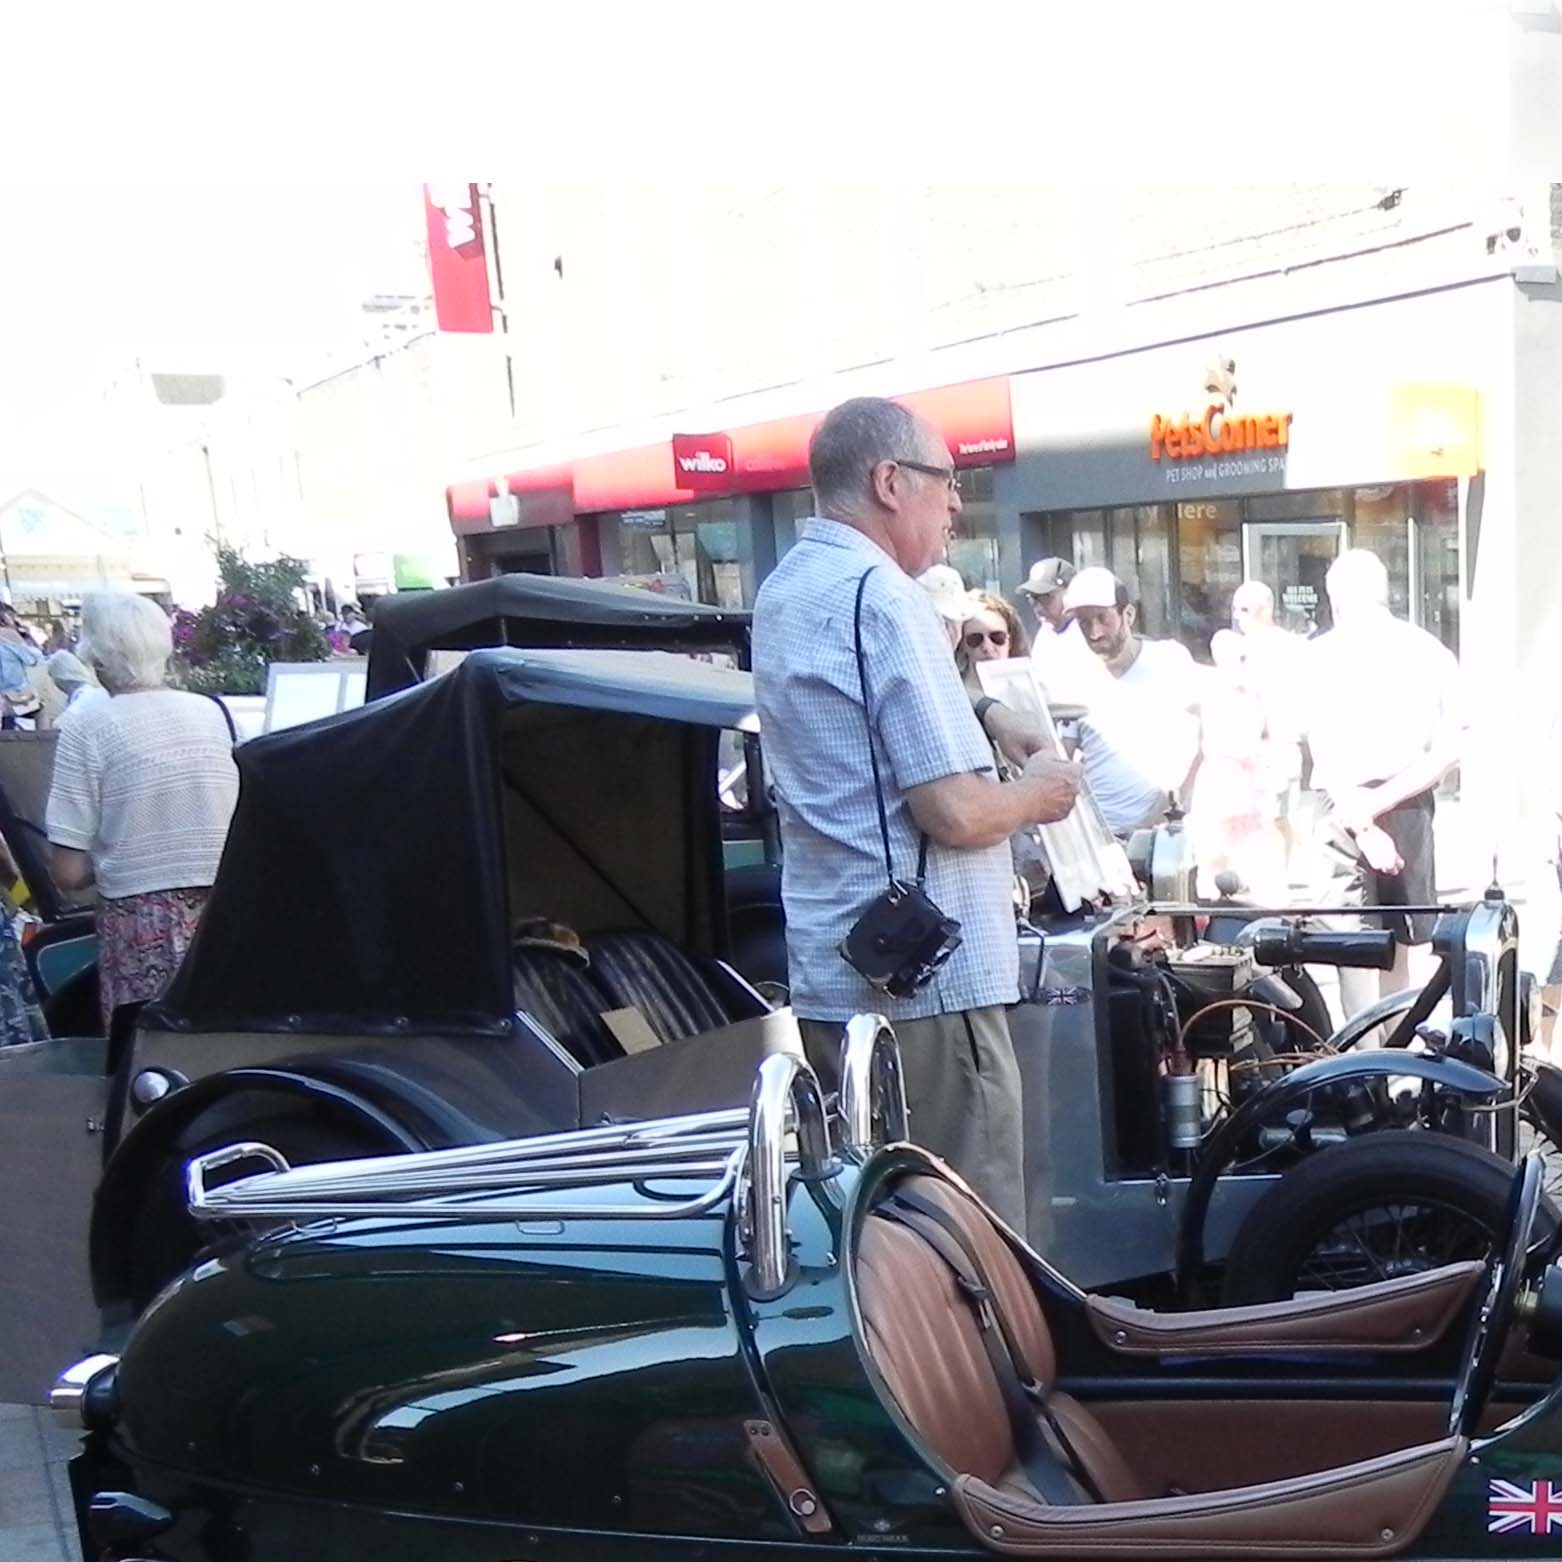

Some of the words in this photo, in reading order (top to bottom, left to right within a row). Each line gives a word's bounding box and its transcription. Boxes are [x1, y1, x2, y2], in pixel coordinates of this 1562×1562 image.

[679, 451, 727, 472] wilko
[1166, 467, 1179, 482] PET
[1181, 464, 1203, 480] SHOP
[1218, 459, 1267, 478] GROOMING
